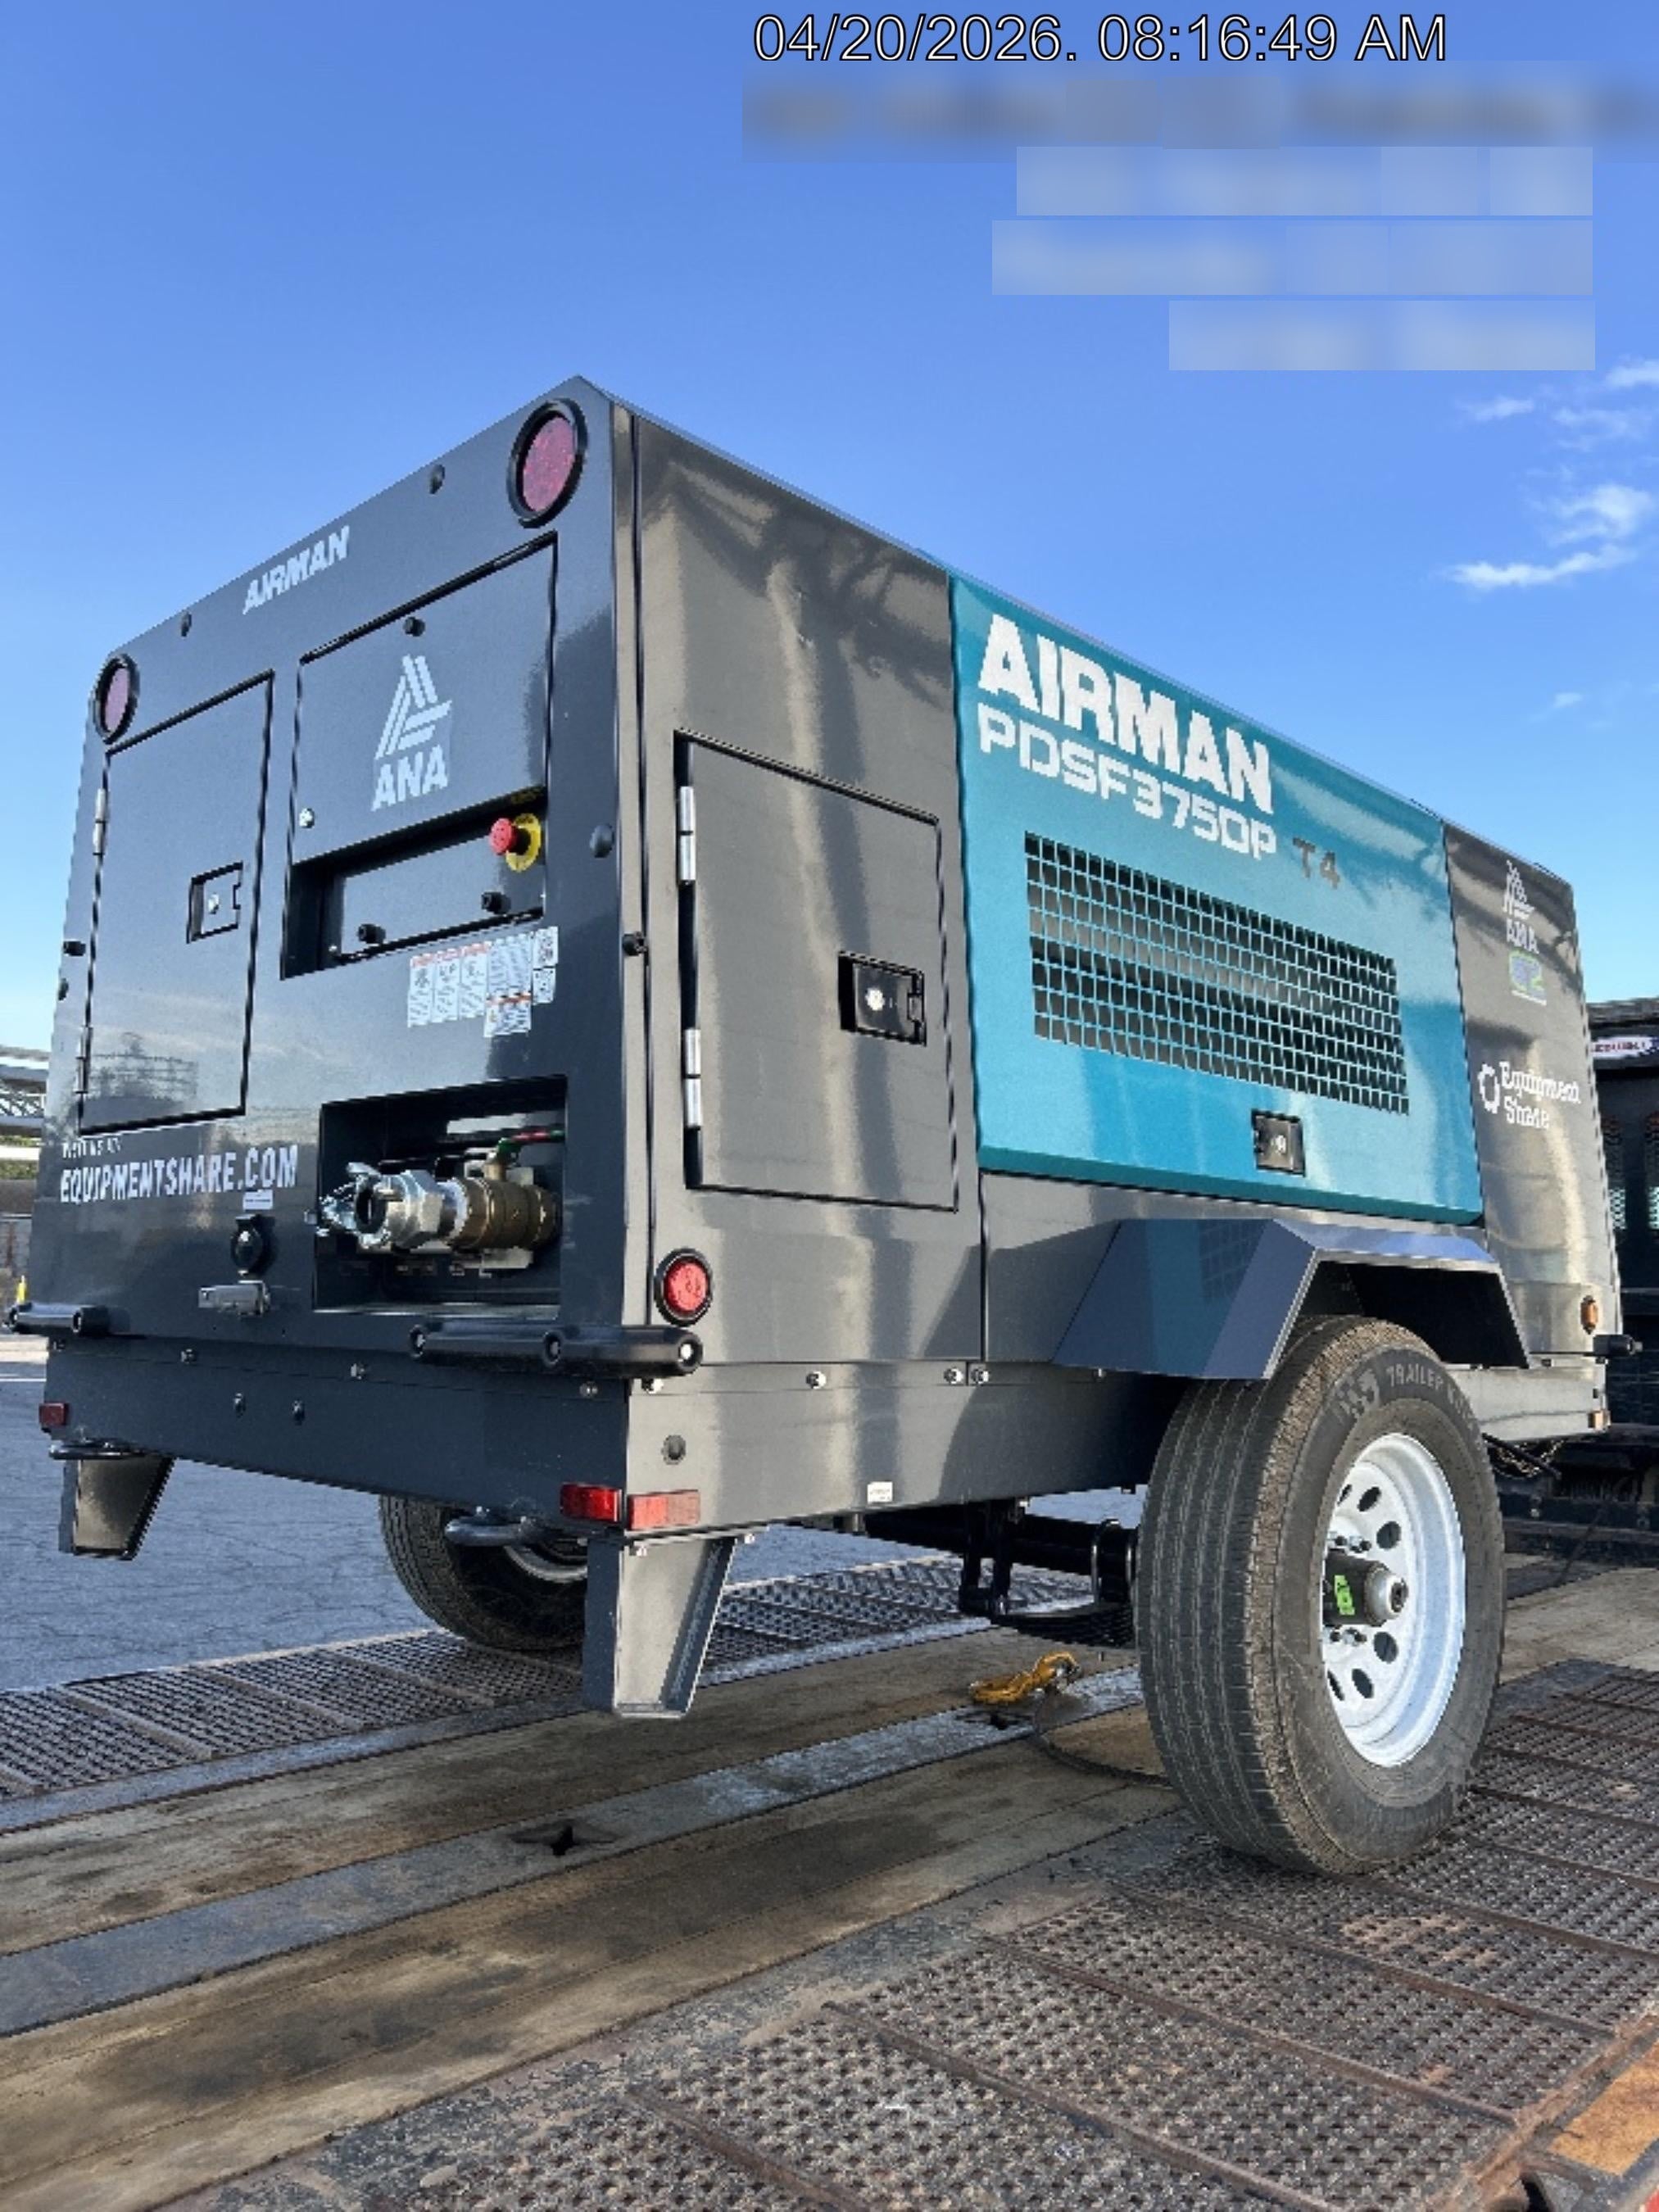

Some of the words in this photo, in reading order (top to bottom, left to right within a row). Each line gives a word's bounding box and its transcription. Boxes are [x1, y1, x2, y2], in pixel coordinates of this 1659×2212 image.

[243, 525, 350, 614] AIRMAN
[977, 613, 1274, 815] AIRMAN
[371, 744, 448, 812] ANA
[1292, 836, 1340, 889] T4
[60, 1144, 298, 1205] EQUIPMENTSHARE.COM
